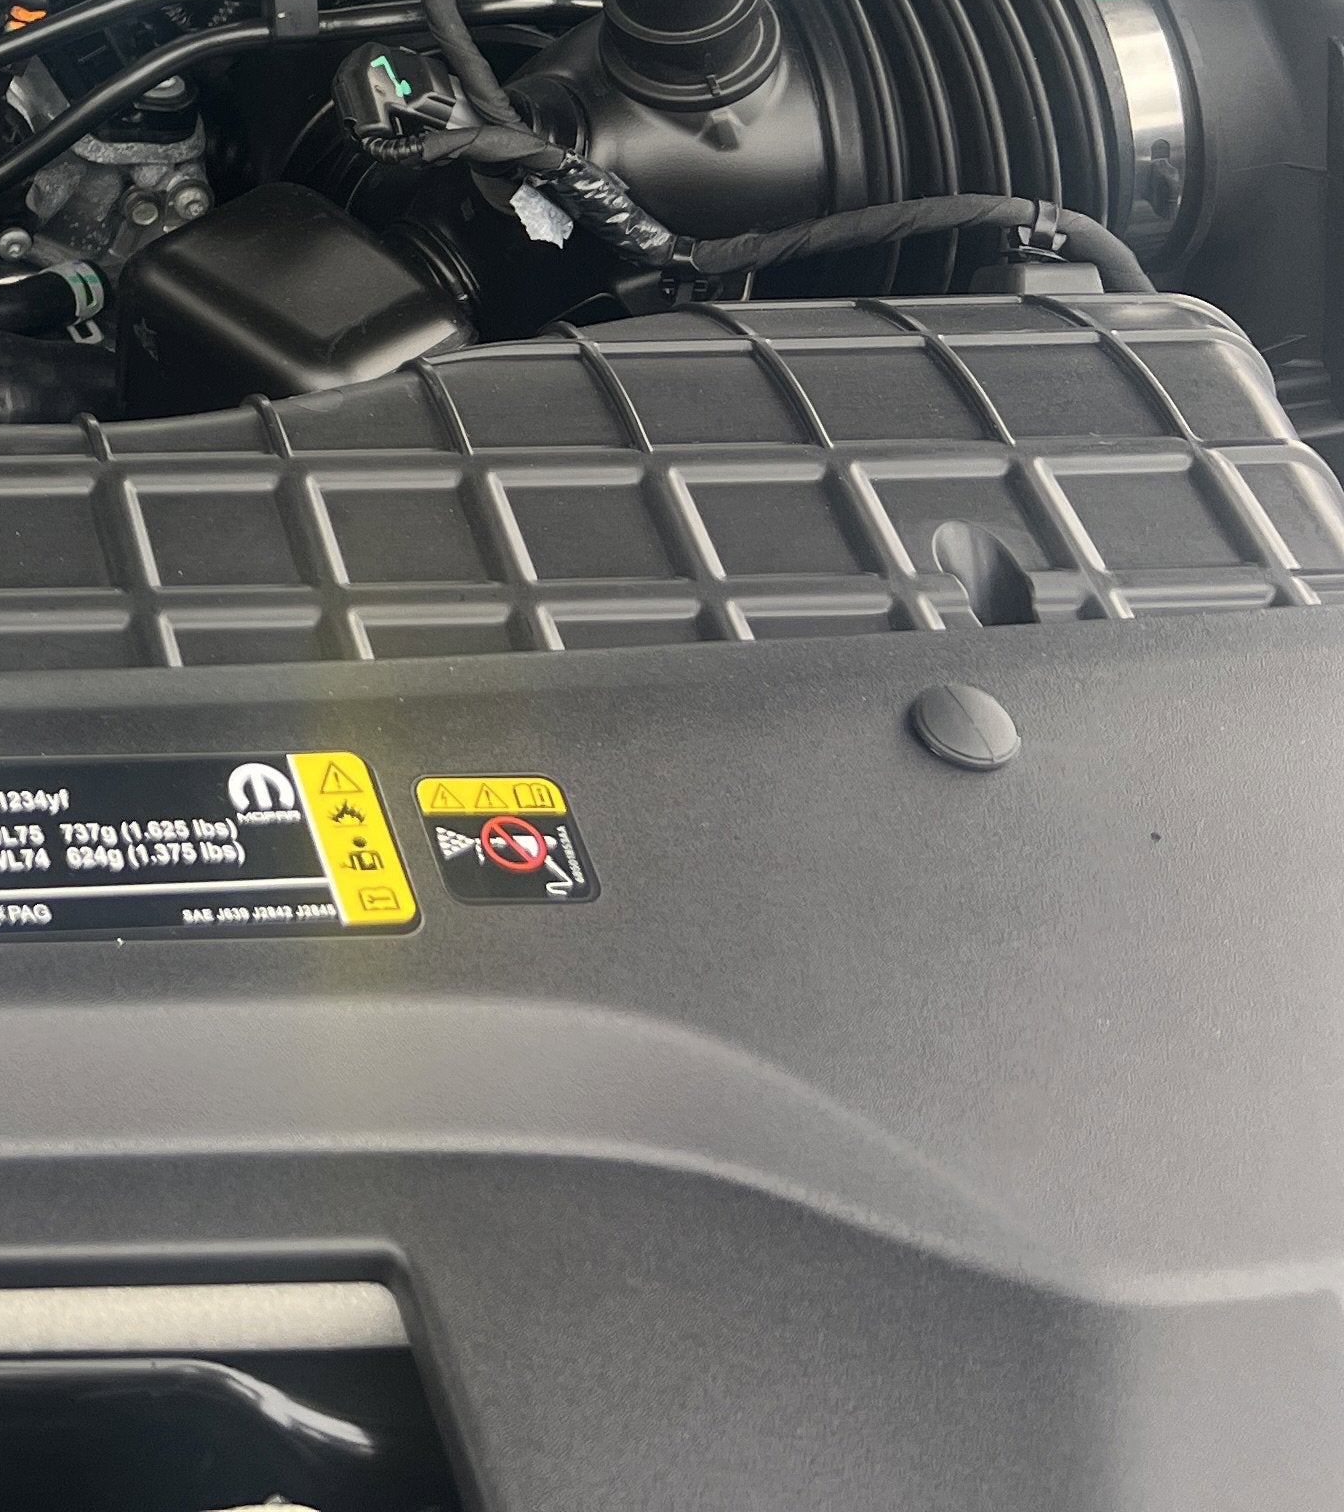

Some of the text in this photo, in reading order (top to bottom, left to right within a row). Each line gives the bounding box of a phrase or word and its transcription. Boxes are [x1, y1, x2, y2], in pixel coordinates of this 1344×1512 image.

[59, 822, 118, 846] 737g
[120, 820, 190, 844] (1.625
[191, 817, 238, 842] lbs)
[66, 845, 125, 872] 624g
[127, 842, 198, 870] (1.375
[199, 840, 246, 868] lbs)
[7, 903, 53, 926] PAG
[181, 908, 215, 923] SAE
